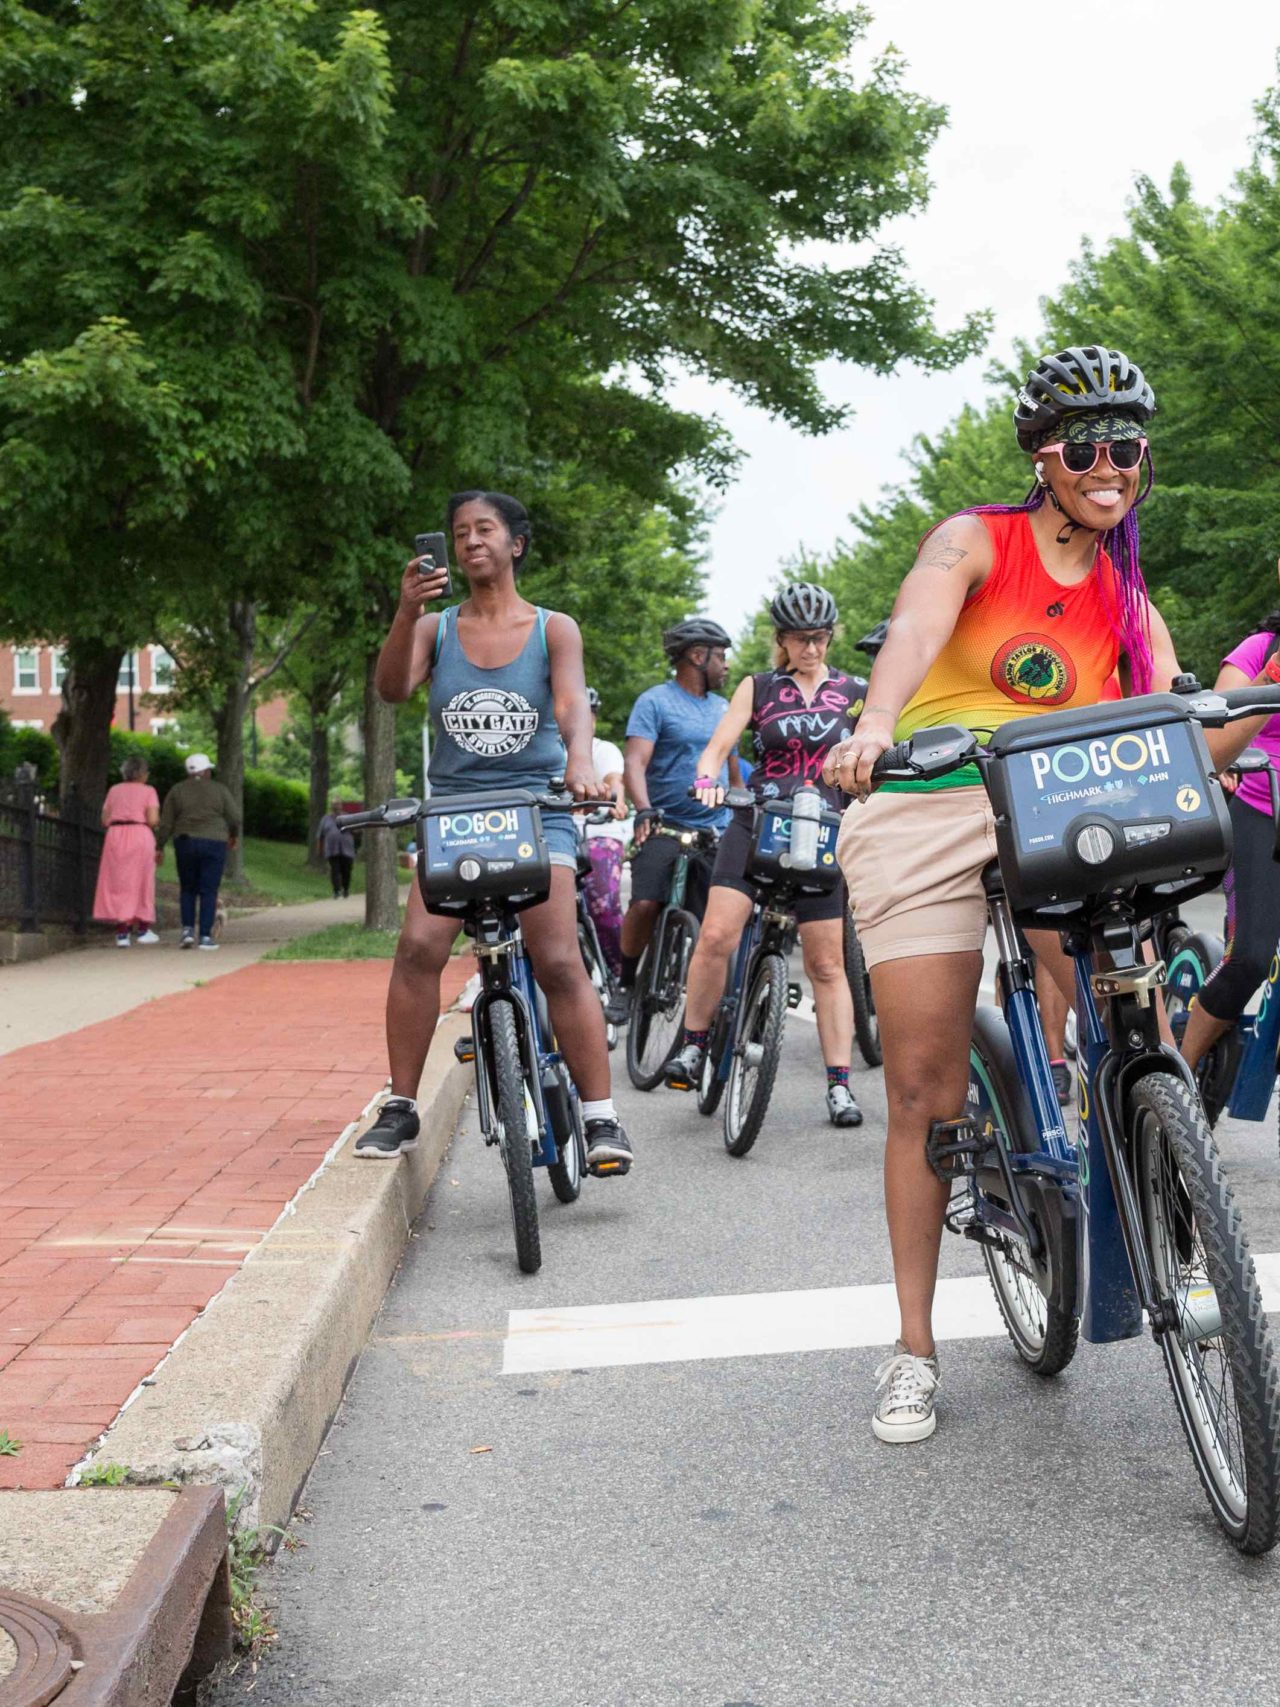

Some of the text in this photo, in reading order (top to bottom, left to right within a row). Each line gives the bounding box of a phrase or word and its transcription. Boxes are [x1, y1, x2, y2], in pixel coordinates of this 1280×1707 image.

[1011, 646, 1037, 662] TAYLOR
[446, 714, 535, 731] CITY GATE
[777, 713, 839, 741] my
[468, 734, 517, 754] SPIRITS
[764, 738, 829, 779] Bik
[1030, 728, 1170, 790] POGOH
[1047, 771, 1169, 805] HIGHMARK AHN
[439, 809, 519, 838] POGOH
[772, 815, 831, 844] POH
